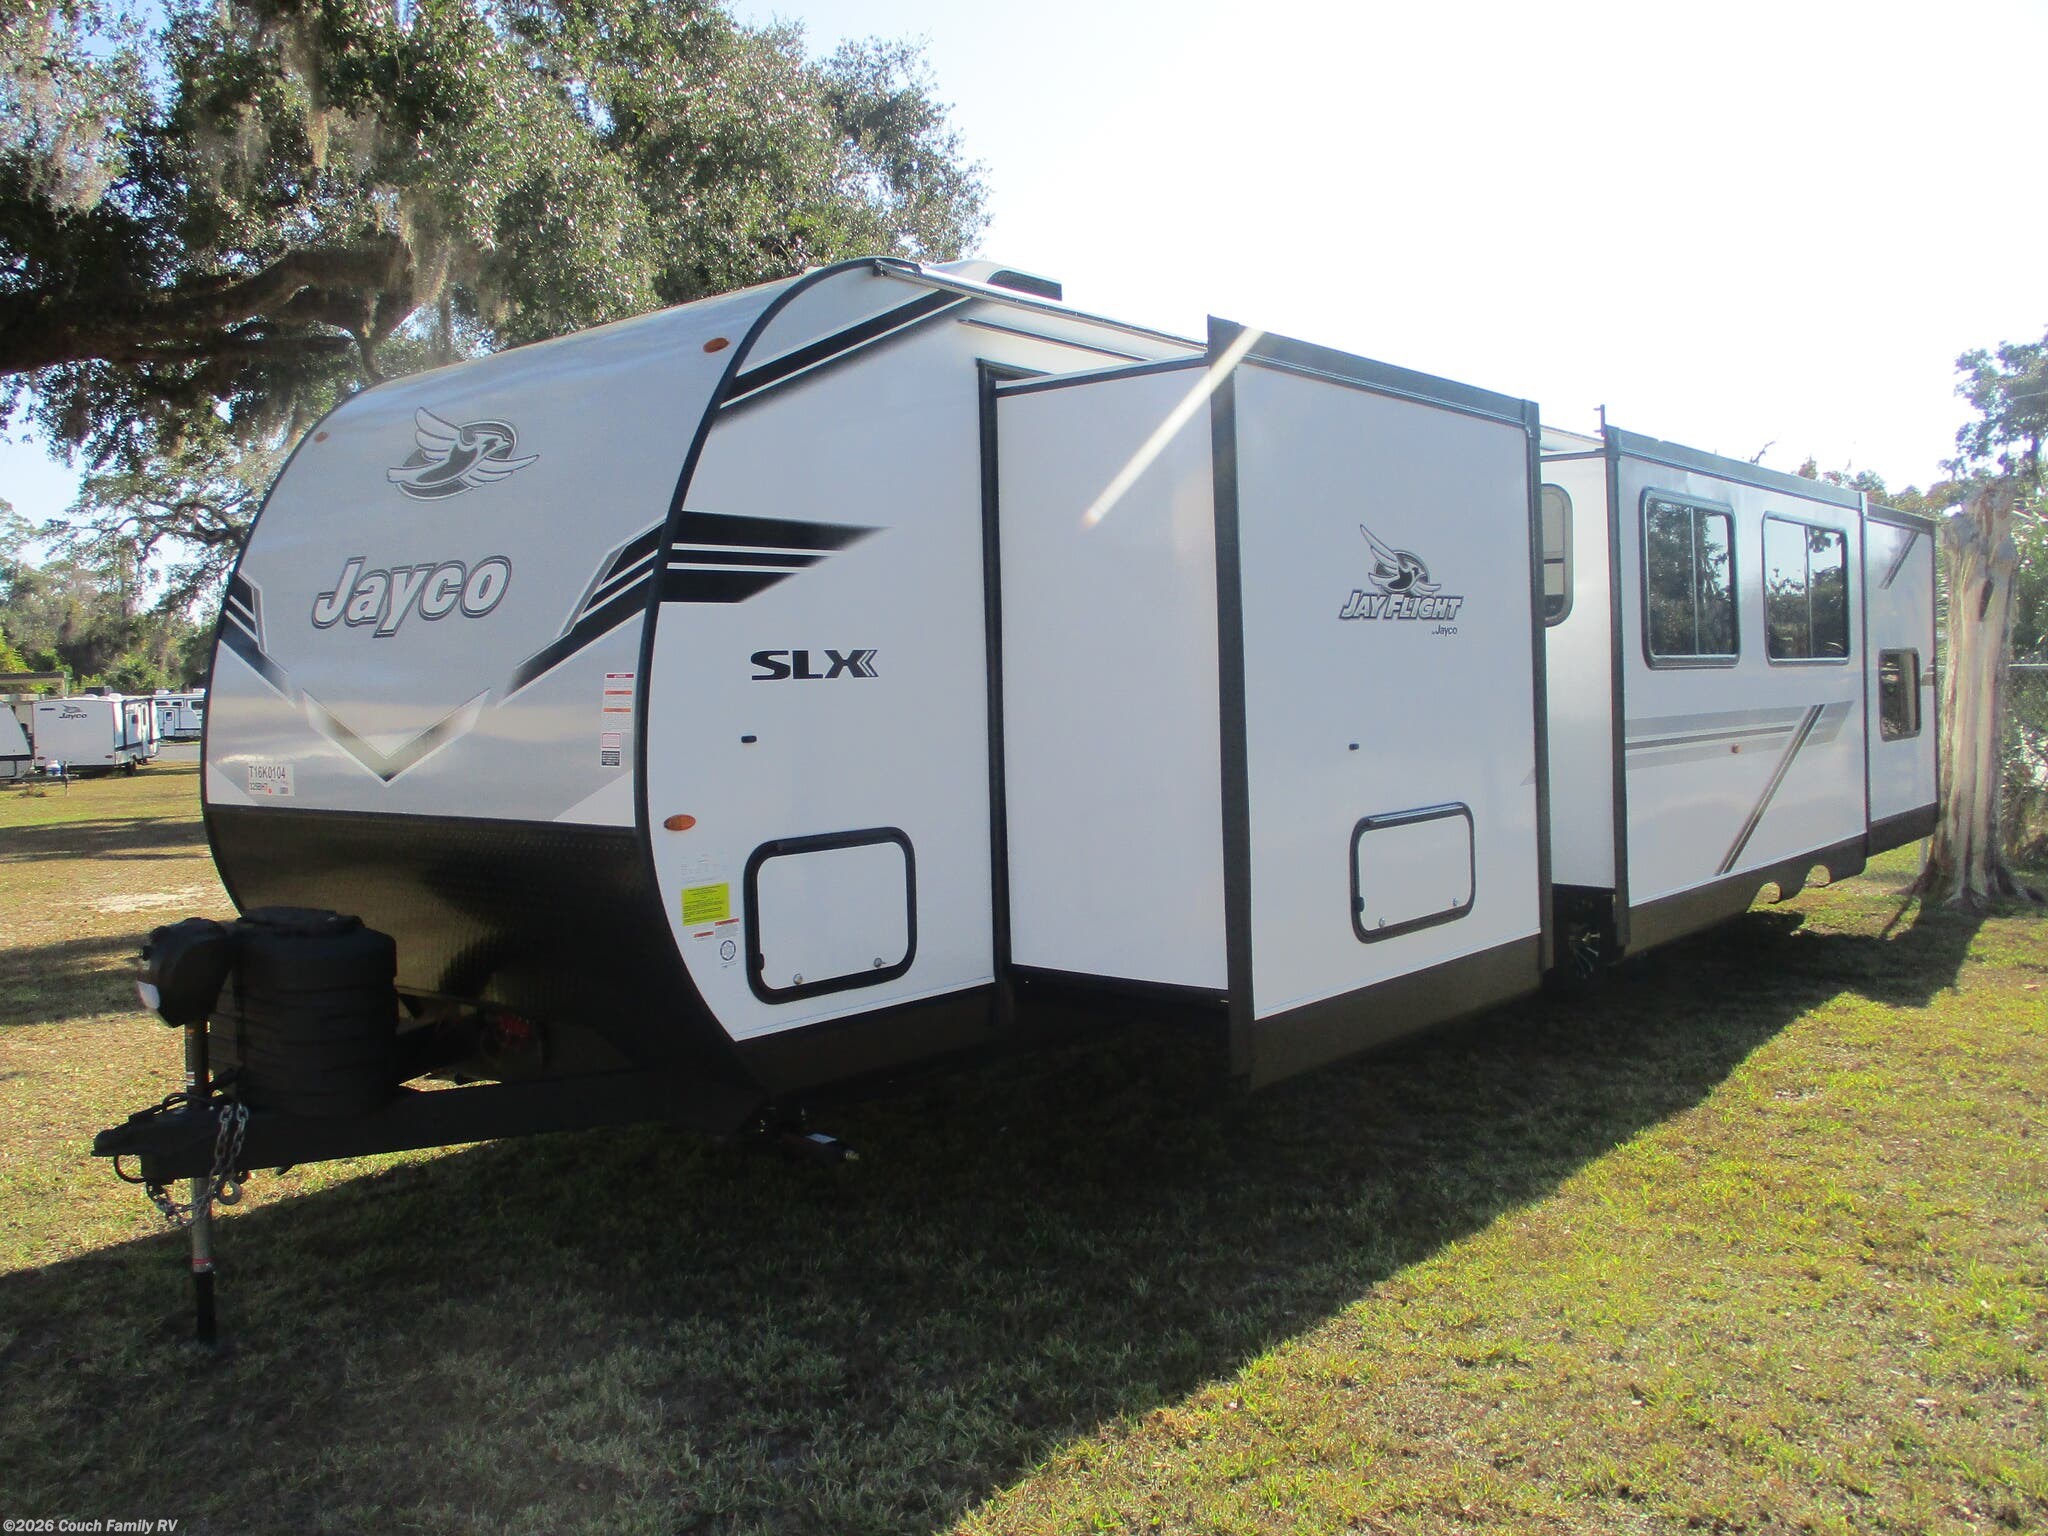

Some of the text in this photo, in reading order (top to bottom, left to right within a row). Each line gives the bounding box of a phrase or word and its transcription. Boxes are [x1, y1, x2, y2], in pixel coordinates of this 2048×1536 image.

[311, 555, 513, 638] Jayco
[1339, 589, 1464, 620] JAY FLIGHT
[750, 649, 879, 680] SLX
